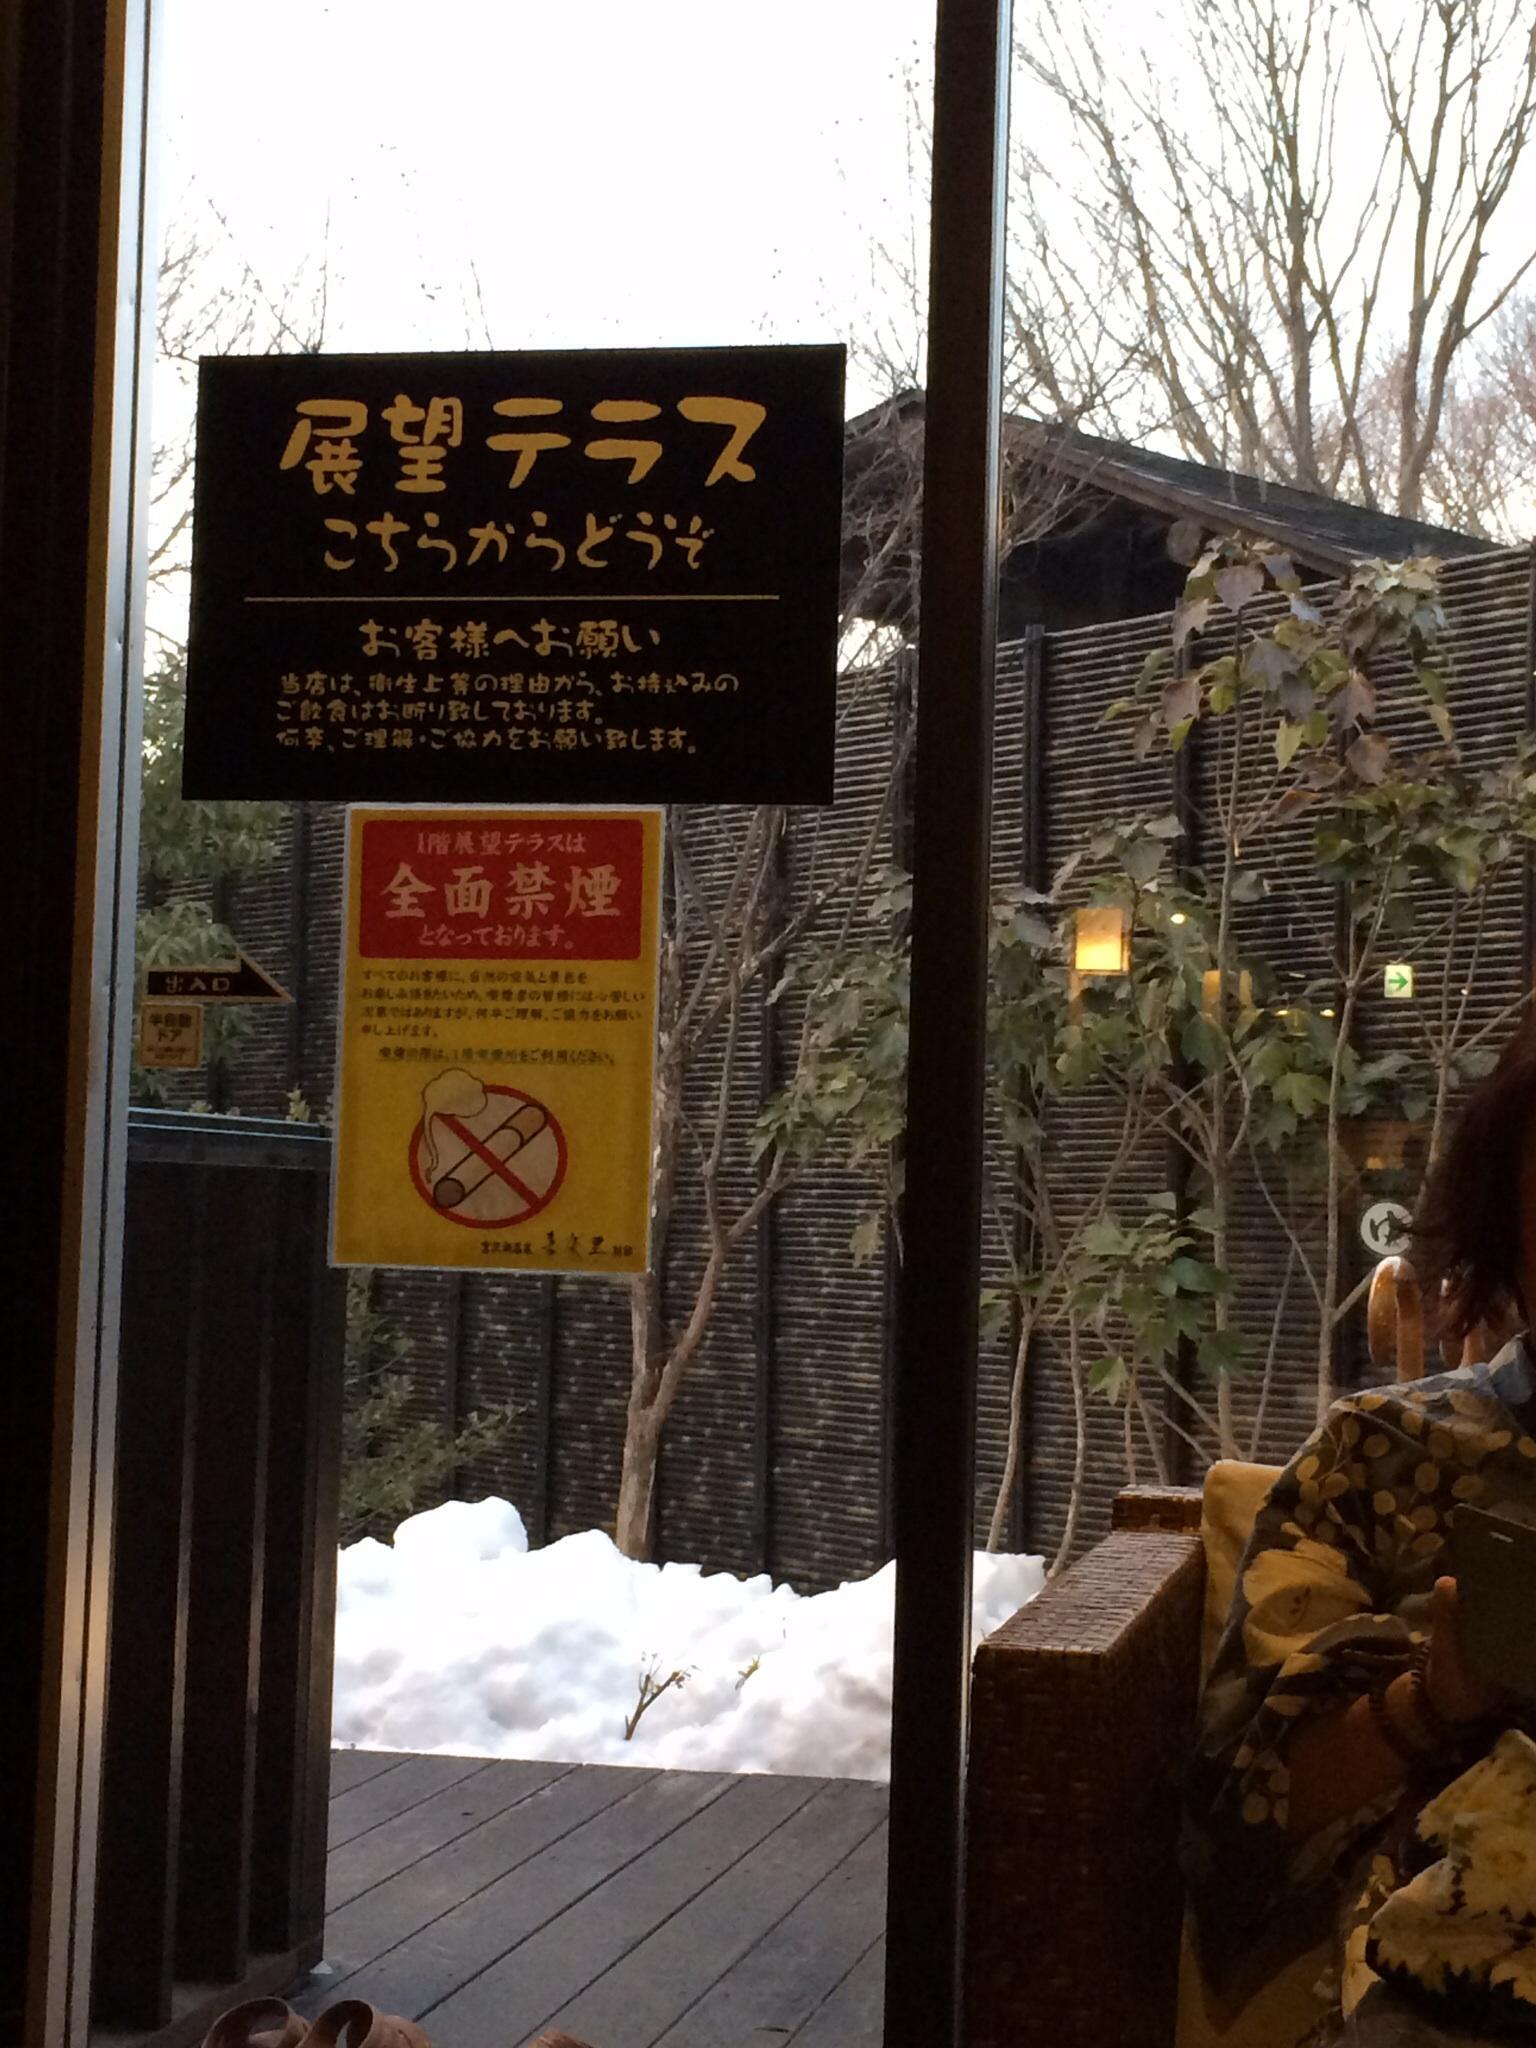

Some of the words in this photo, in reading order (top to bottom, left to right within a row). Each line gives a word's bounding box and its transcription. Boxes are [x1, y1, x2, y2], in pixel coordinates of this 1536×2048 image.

[279, 393, 767, 495] 展望テラス
[324, 511, 714, 571] こちらからどうぞ
[359, 619, 660, 660] お客様へお願い
[379, 860, 622, 920] 全面禁煙
[418, 924, 574, 949] となっております。
